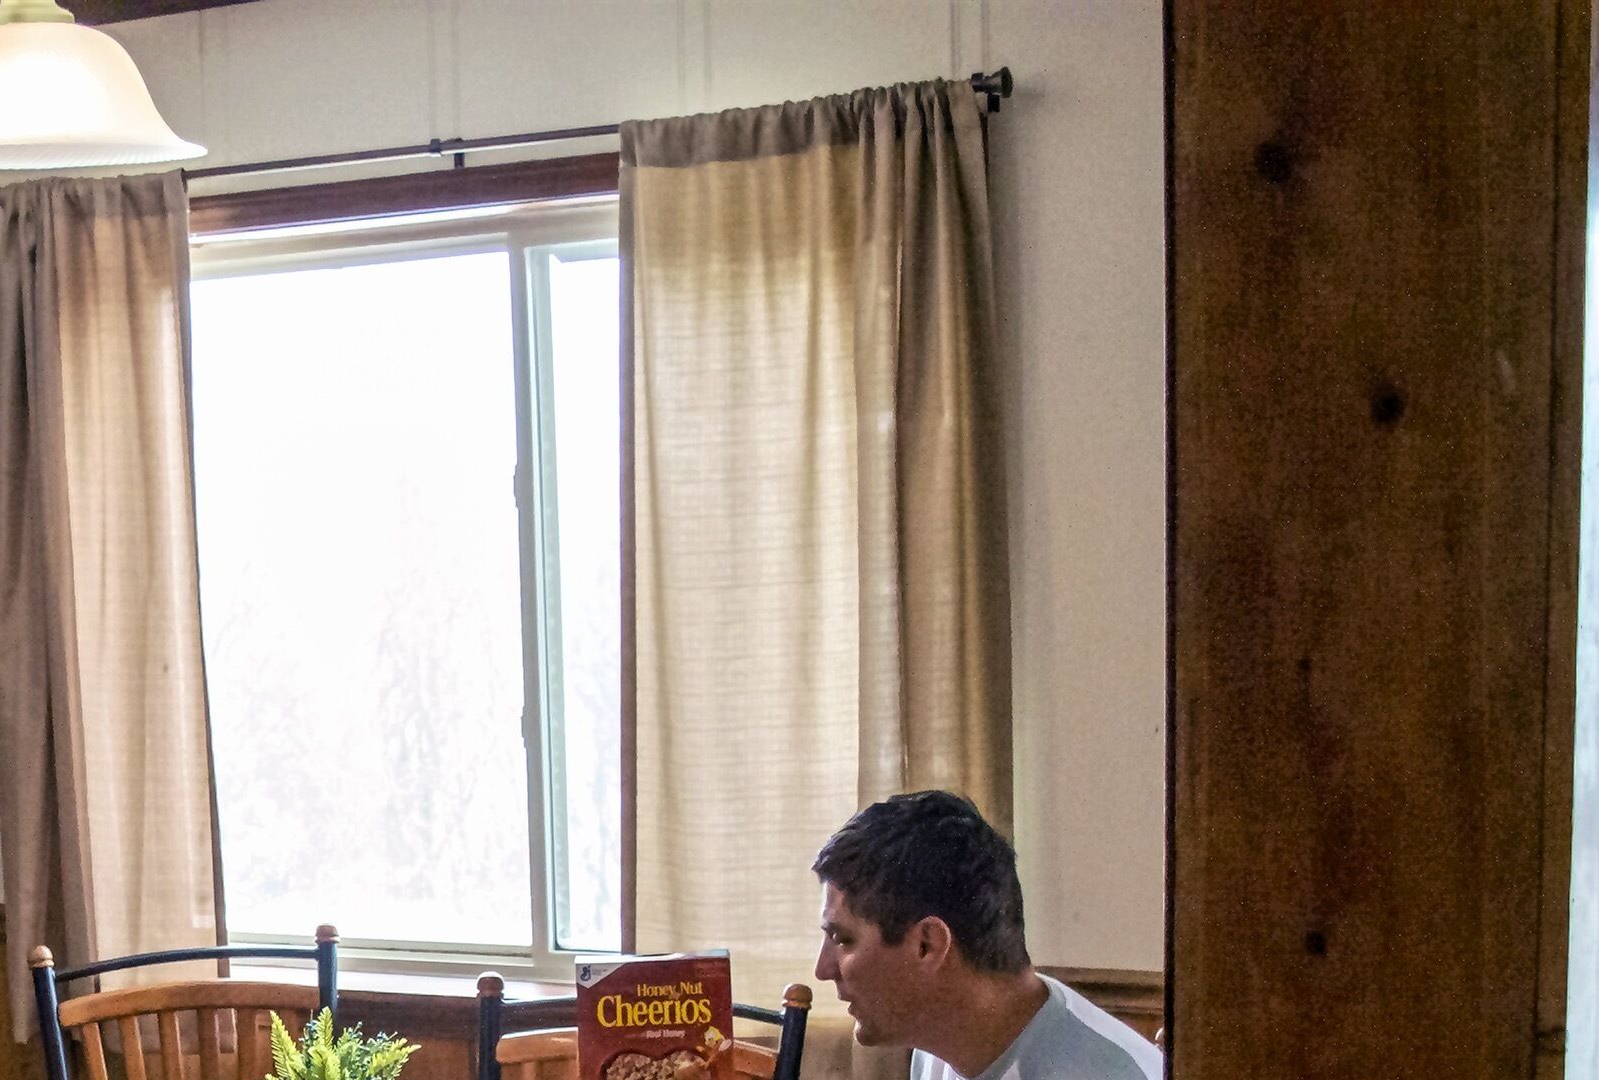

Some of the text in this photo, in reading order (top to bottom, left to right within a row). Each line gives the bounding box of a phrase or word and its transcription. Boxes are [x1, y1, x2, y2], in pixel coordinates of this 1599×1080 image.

[637, 981, 703, 997] Honey Nut
[597, 995, 712, 1028] Cheerios
